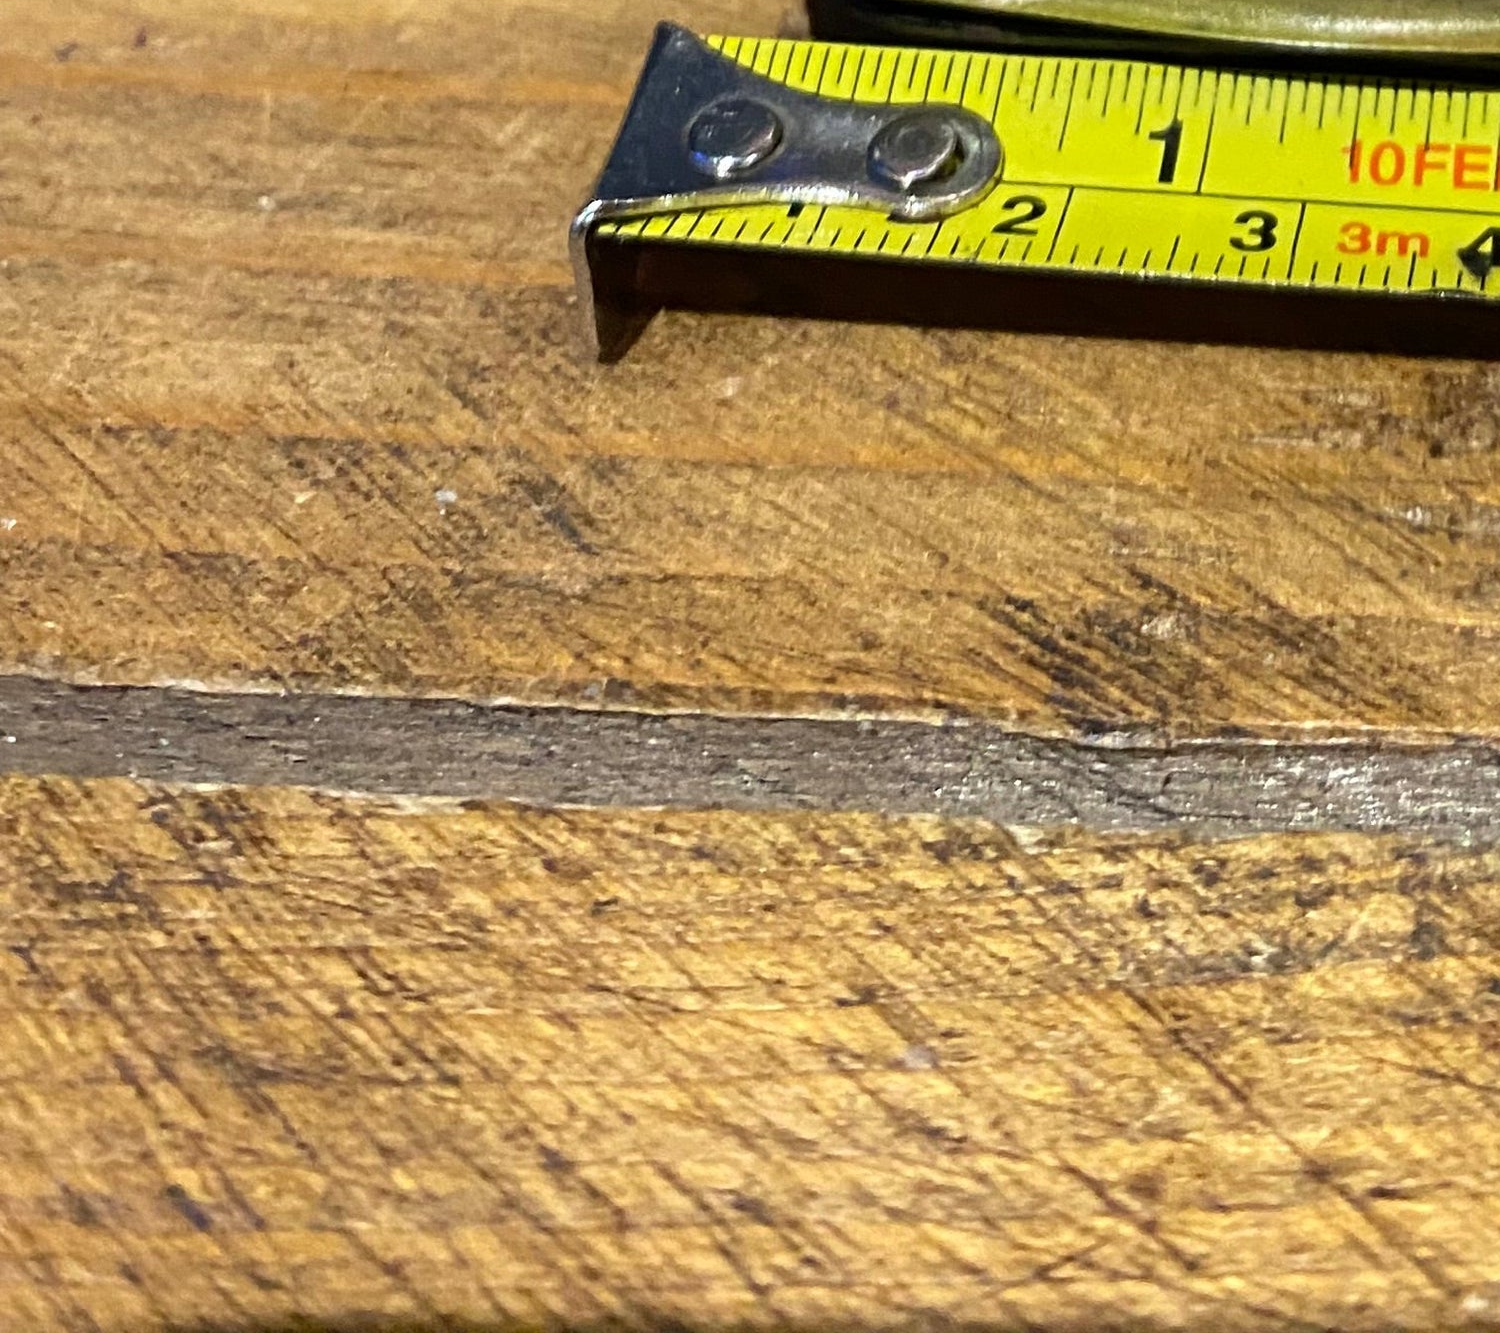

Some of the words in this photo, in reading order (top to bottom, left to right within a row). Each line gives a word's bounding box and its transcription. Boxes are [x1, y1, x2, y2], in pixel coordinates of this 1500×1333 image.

[1147, 117, 1184, 183] 1
[991, 196, 1048, 237] 2
[1228, 210, 1279, 253] 3
[1336, 221, 1430, 258] 3m
